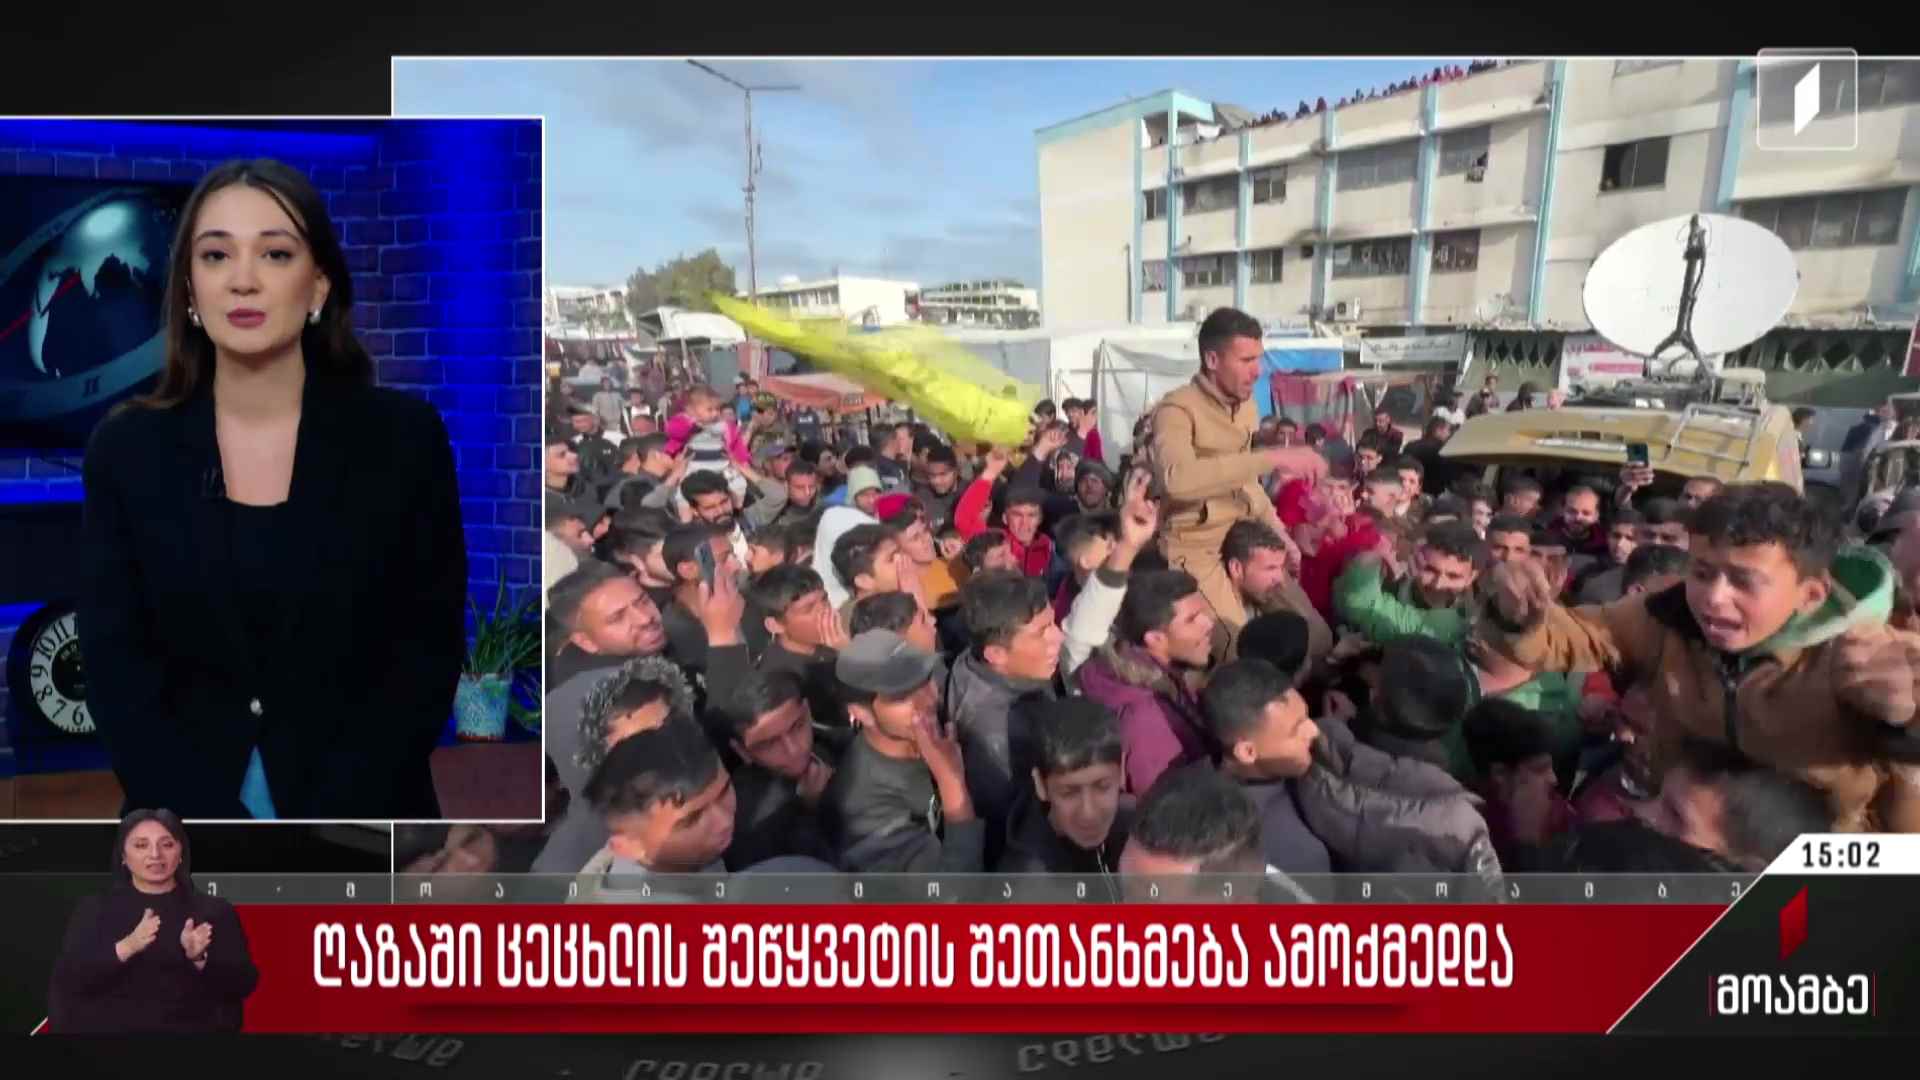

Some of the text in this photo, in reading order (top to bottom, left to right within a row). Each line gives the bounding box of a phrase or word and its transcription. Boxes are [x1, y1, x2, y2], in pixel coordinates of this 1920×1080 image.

[31, 664, 49, 678] 9
[52, 700, 67, 719] 7
[72, 704, 84, 725] 6
